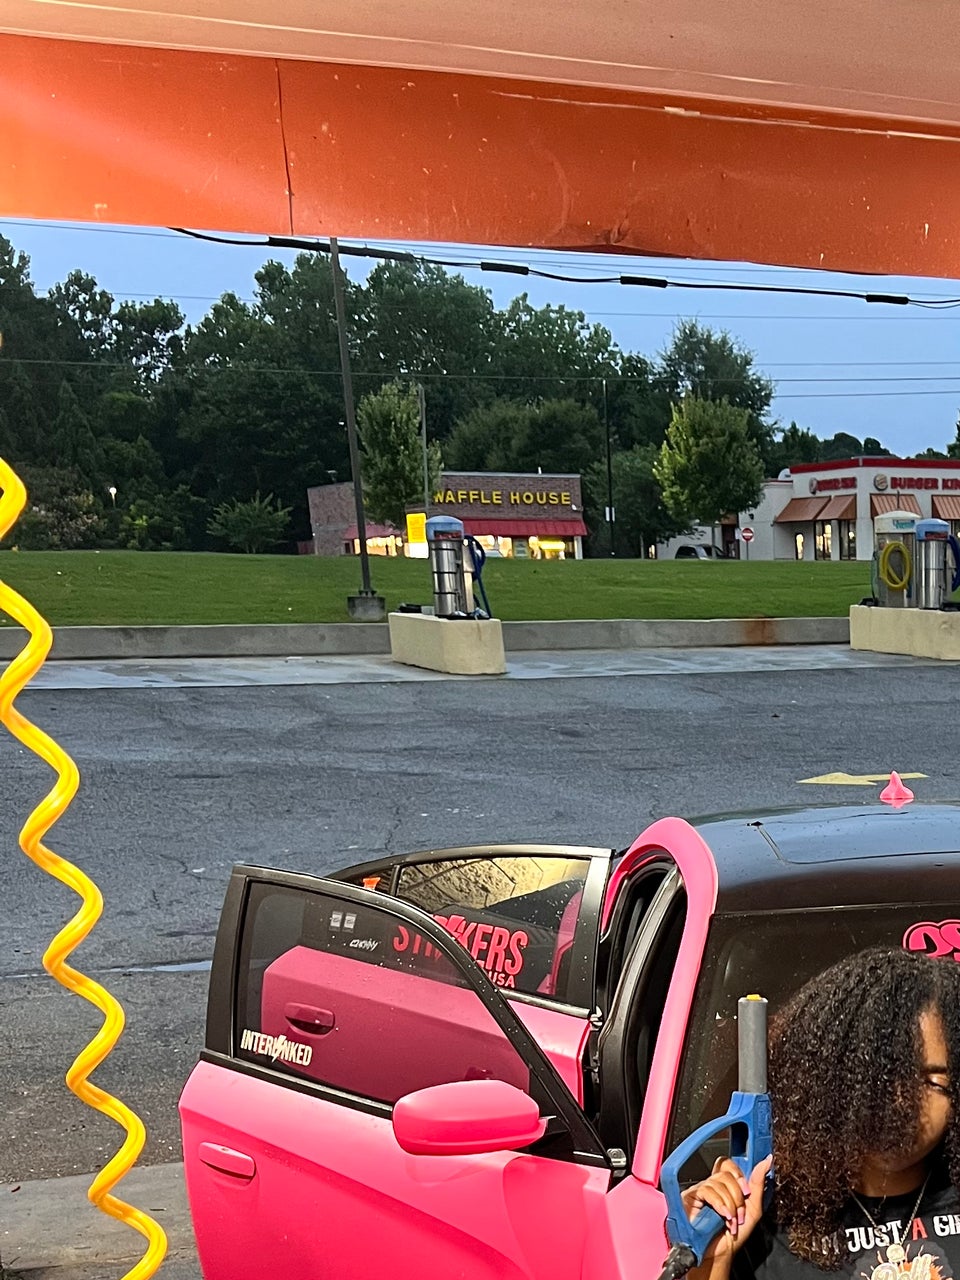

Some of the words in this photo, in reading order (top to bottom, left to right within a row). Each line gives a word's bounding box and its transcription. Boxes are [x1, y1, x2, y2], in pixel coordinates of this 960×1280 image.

[890, 477, 938, 490] BURGER
[434, 490, 502, 504] WAFFLE
[511, 491, 571, 504] HOUSE
[845, 1220, 902, 1252] JUST
[912, 1217, 928, 1241] A
